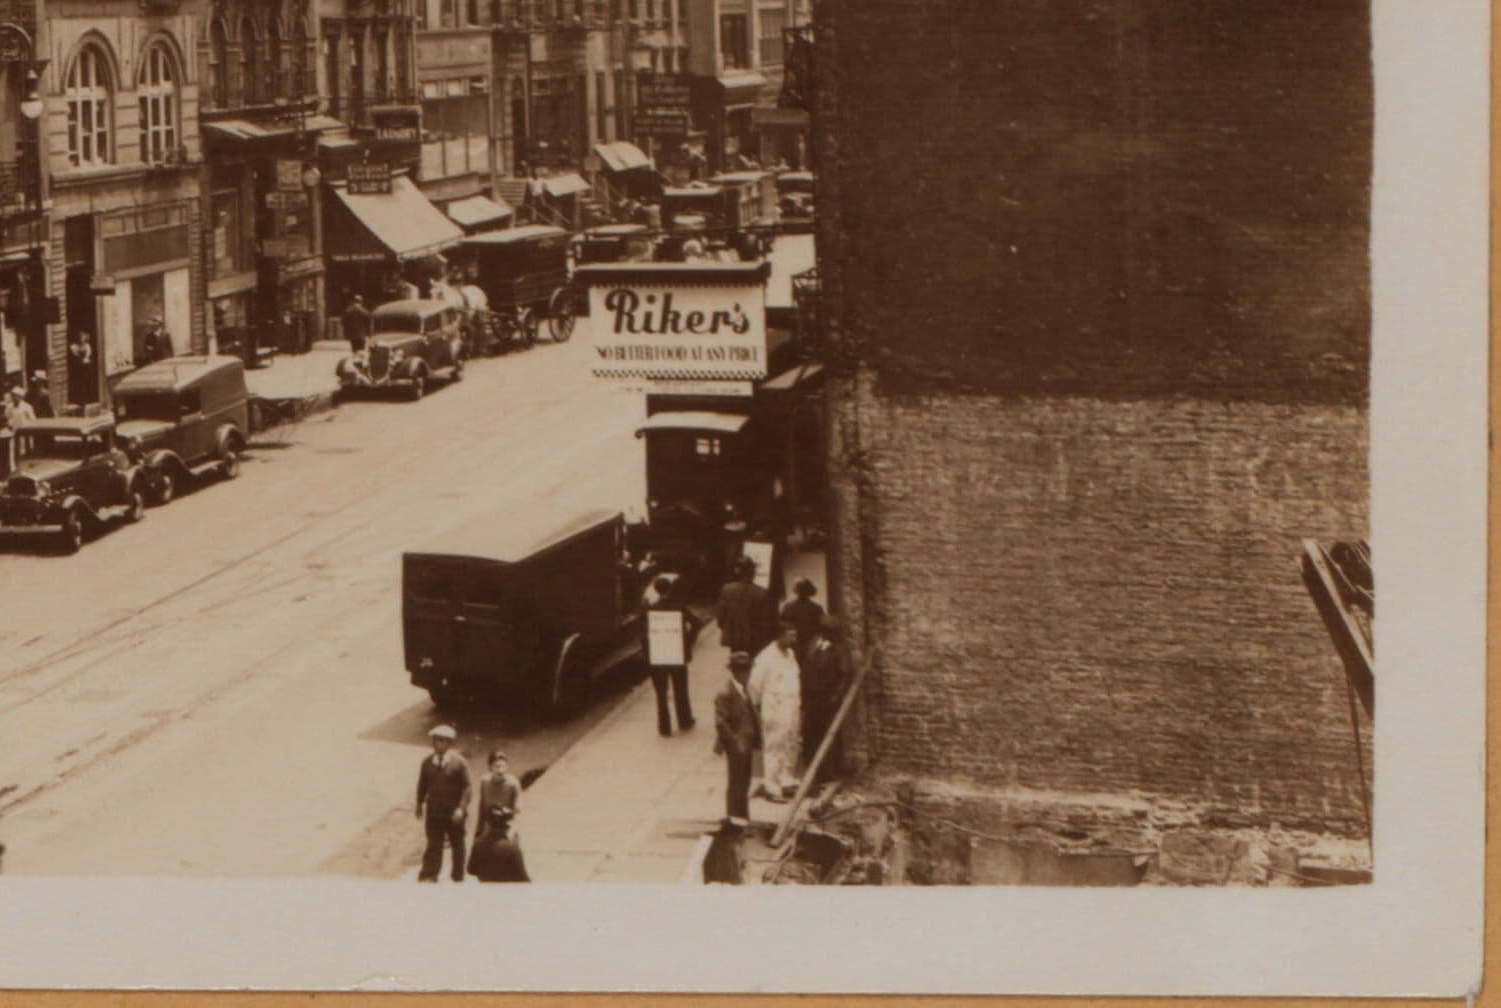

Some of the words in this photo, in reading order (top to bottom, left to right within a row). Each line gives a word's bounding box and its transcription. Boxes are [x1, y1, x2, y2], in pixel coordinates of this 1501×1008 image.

[605, 288, 750, 334] Riker's
[596, 346, 613, 361] NO
[615, 346, 654, 361] BETTER
[654, 346, 687, 361] FOOD
[706, 346, 726, 361] ANY
